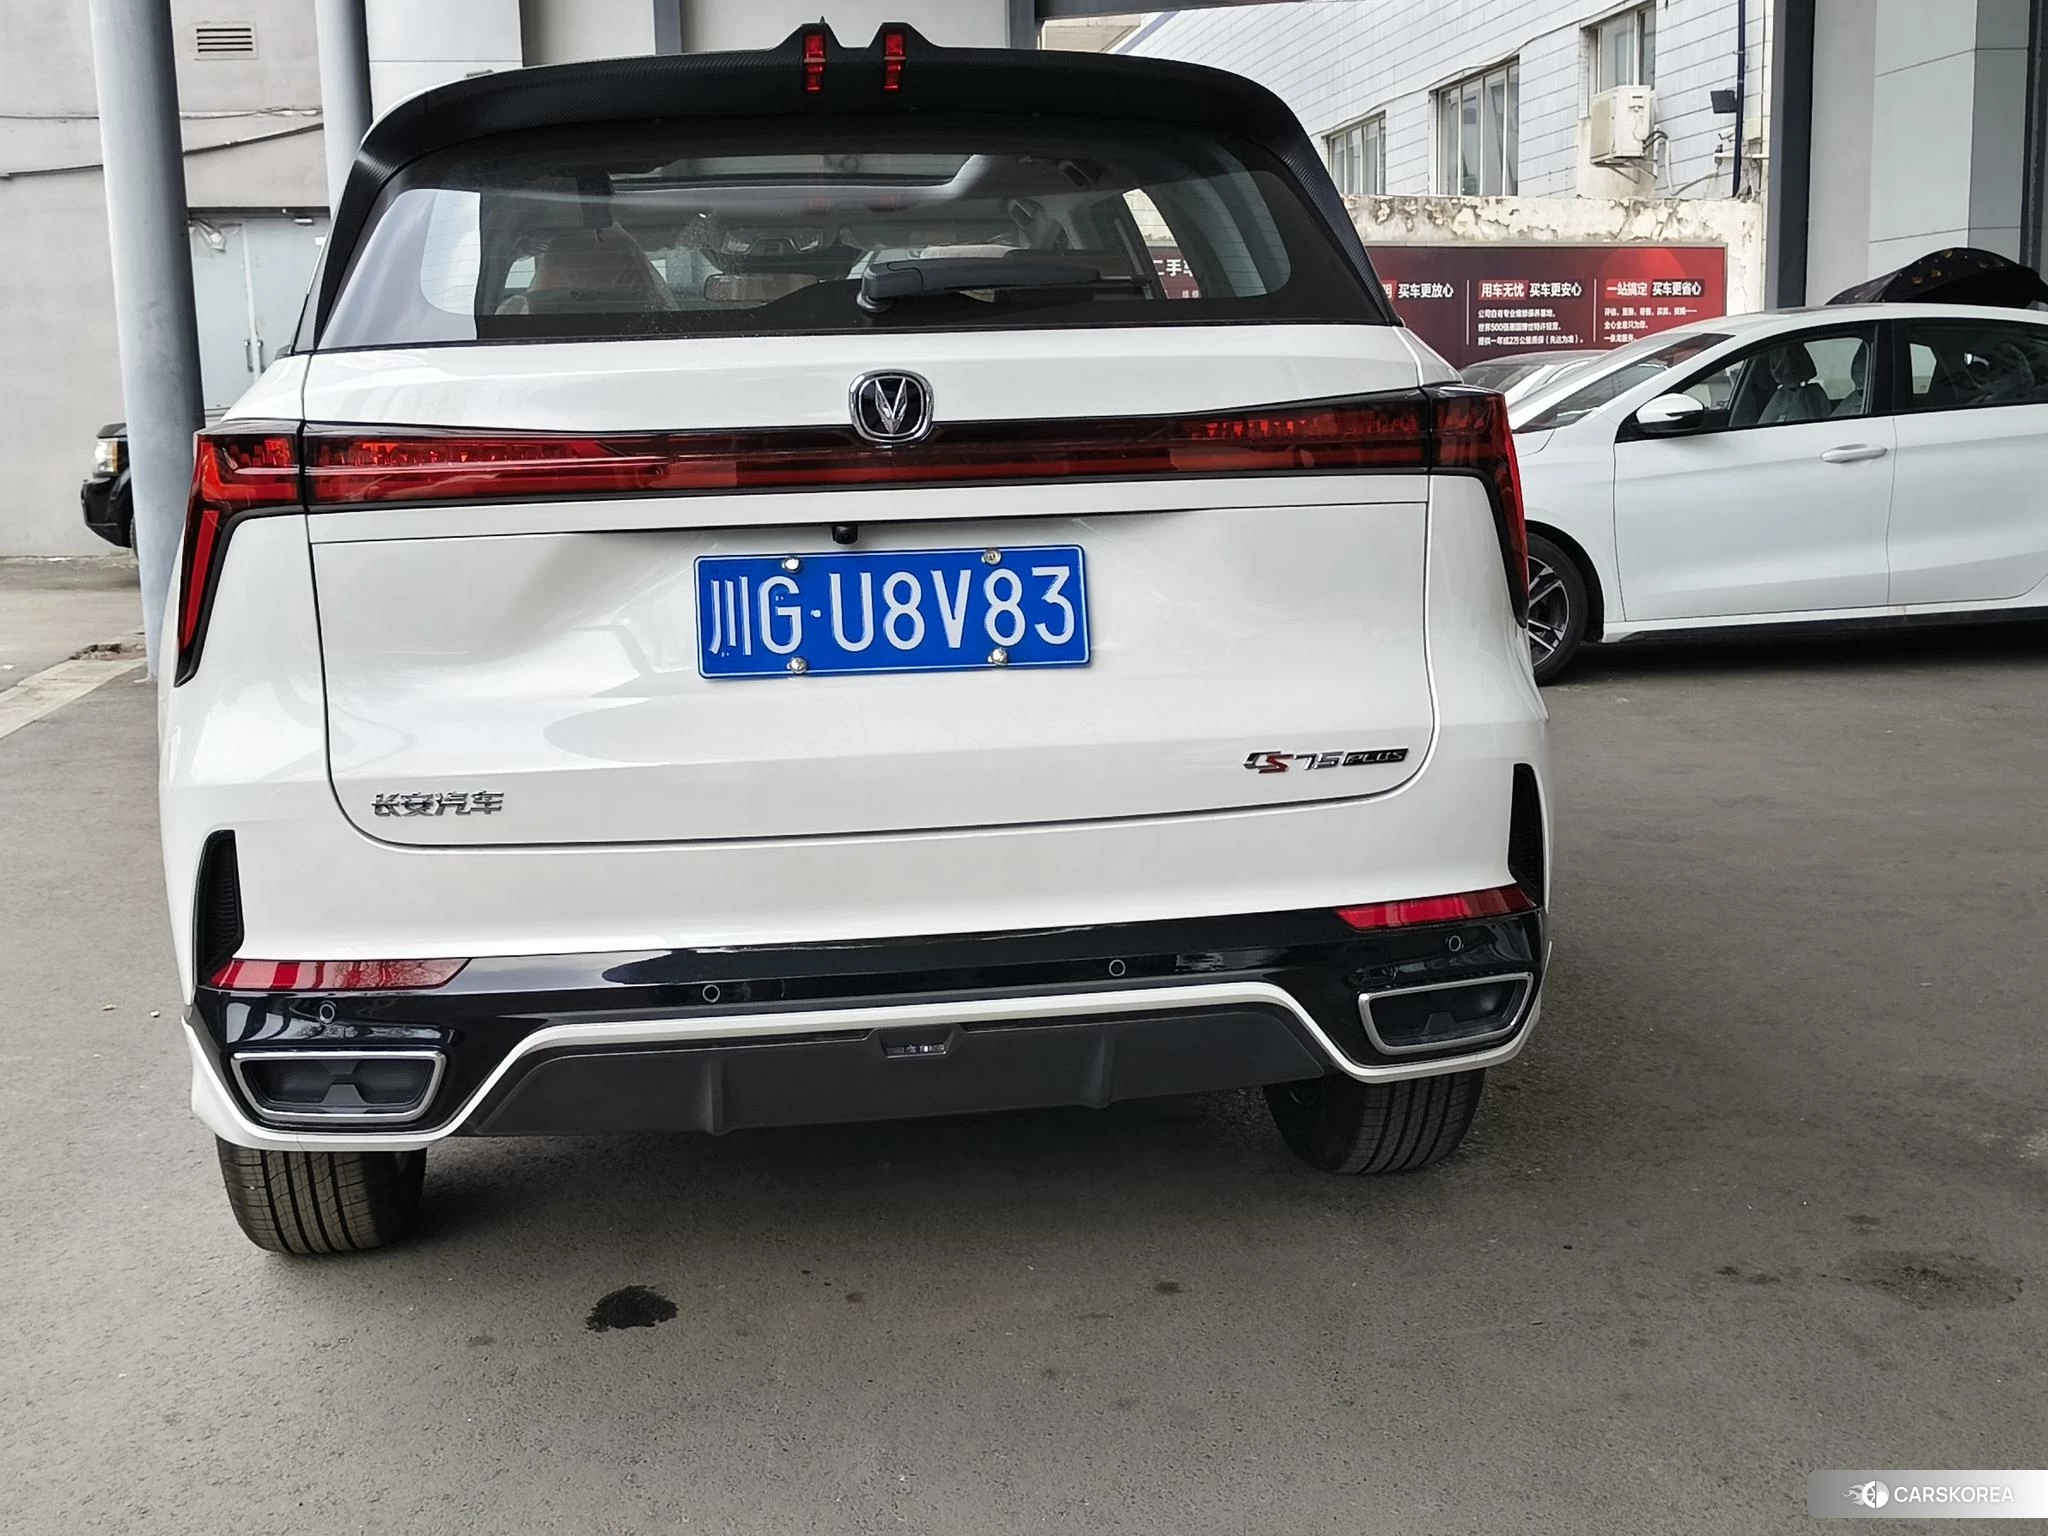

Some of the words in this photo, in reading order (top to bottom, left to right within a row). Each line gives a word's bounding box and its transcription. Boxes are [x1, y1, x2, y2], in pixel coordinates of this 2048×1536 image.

[1398, 283, 1454, 298] 买车更放心
[1481, 283, 1525, 298] 用车无忧
[1529, 282, 1582, 297] 买车更安心
[1607, 281, 1648, 297] 一站搞定
[1652, 281, 1702, 296] 买车更省心
[371, 790, 504, 817] 长安汽车
